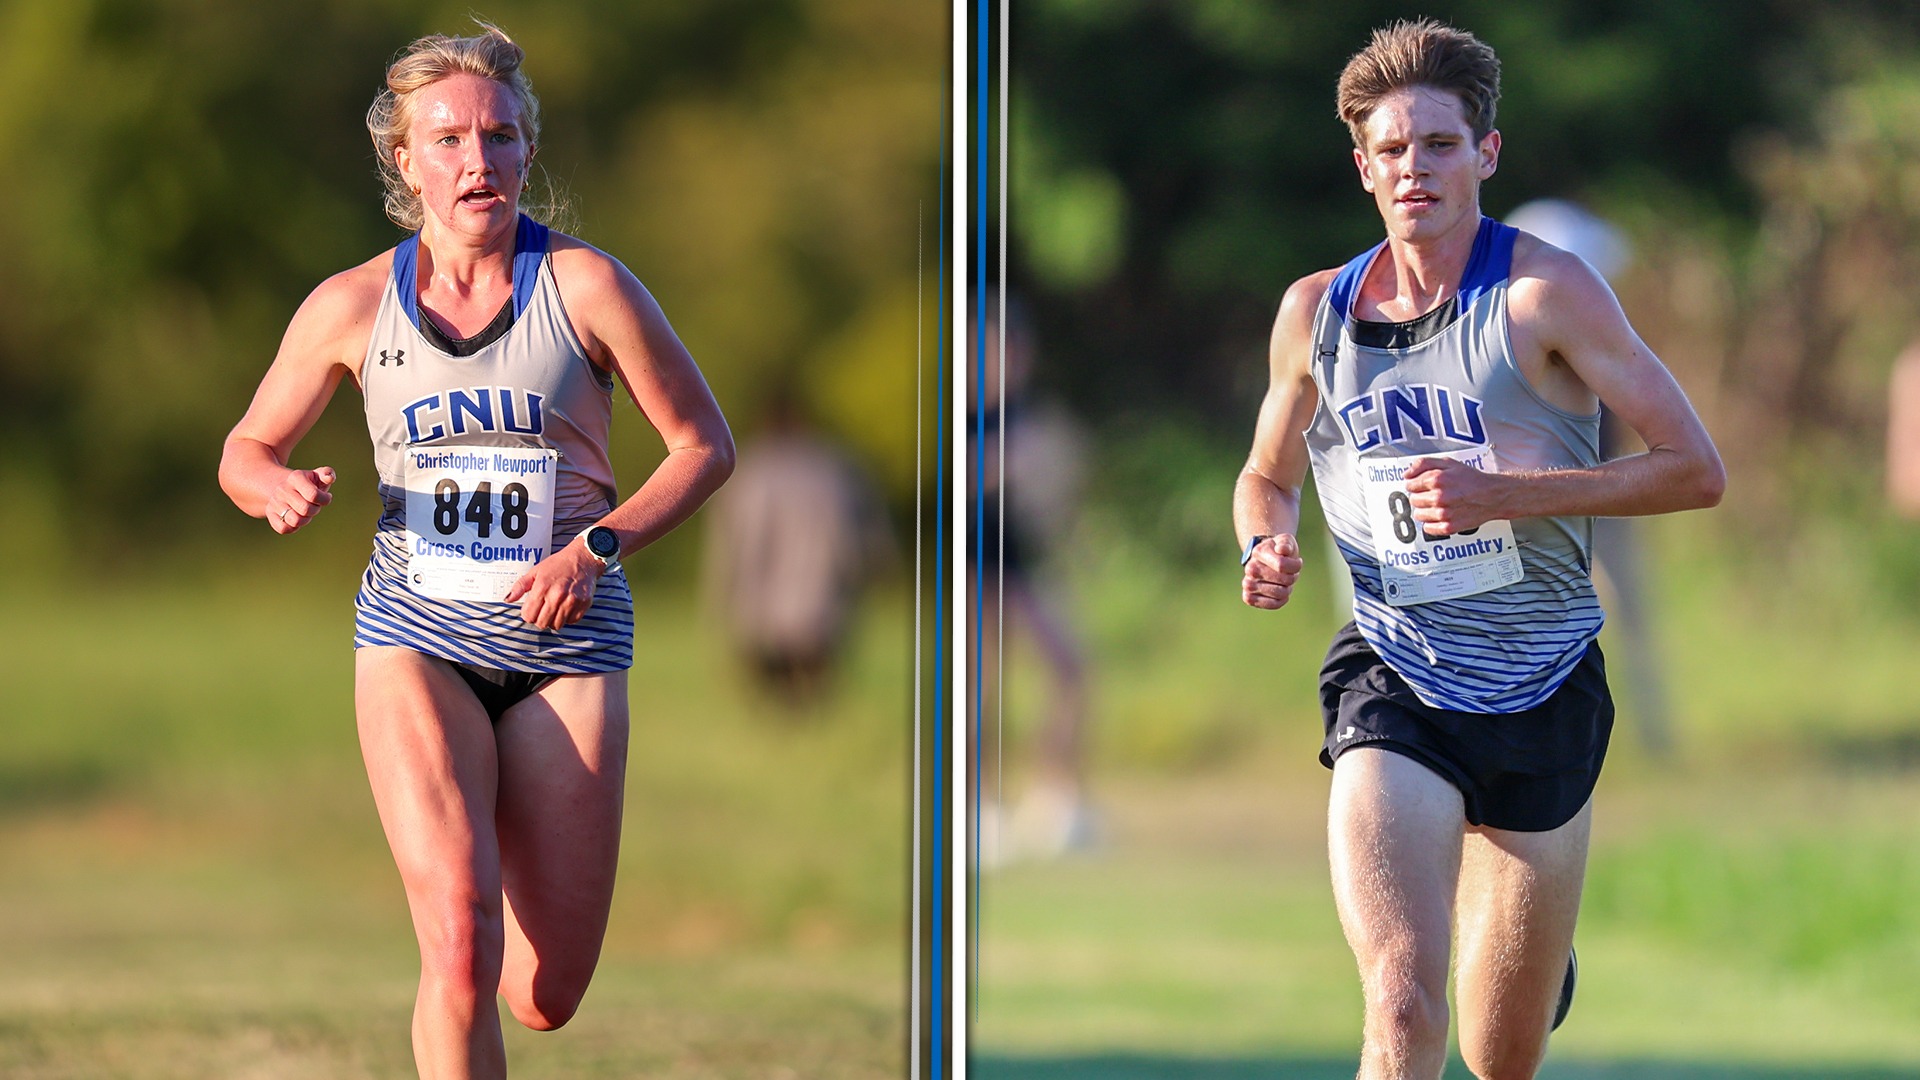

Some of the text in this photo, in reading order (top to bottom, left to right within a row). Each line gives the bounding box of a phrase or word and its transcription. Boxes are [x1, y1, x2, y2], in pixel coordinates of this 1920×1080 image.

[401, 386, 545, 443] CNU
[1337, 384, 1488, 453] CNU
[416, 453, 547, 476] Christopher Newport
[433, 478, 529, 539] 848
[416, 537, 543, 566] Cross Country
[1385, 538, 1503, 567] Cross Country
